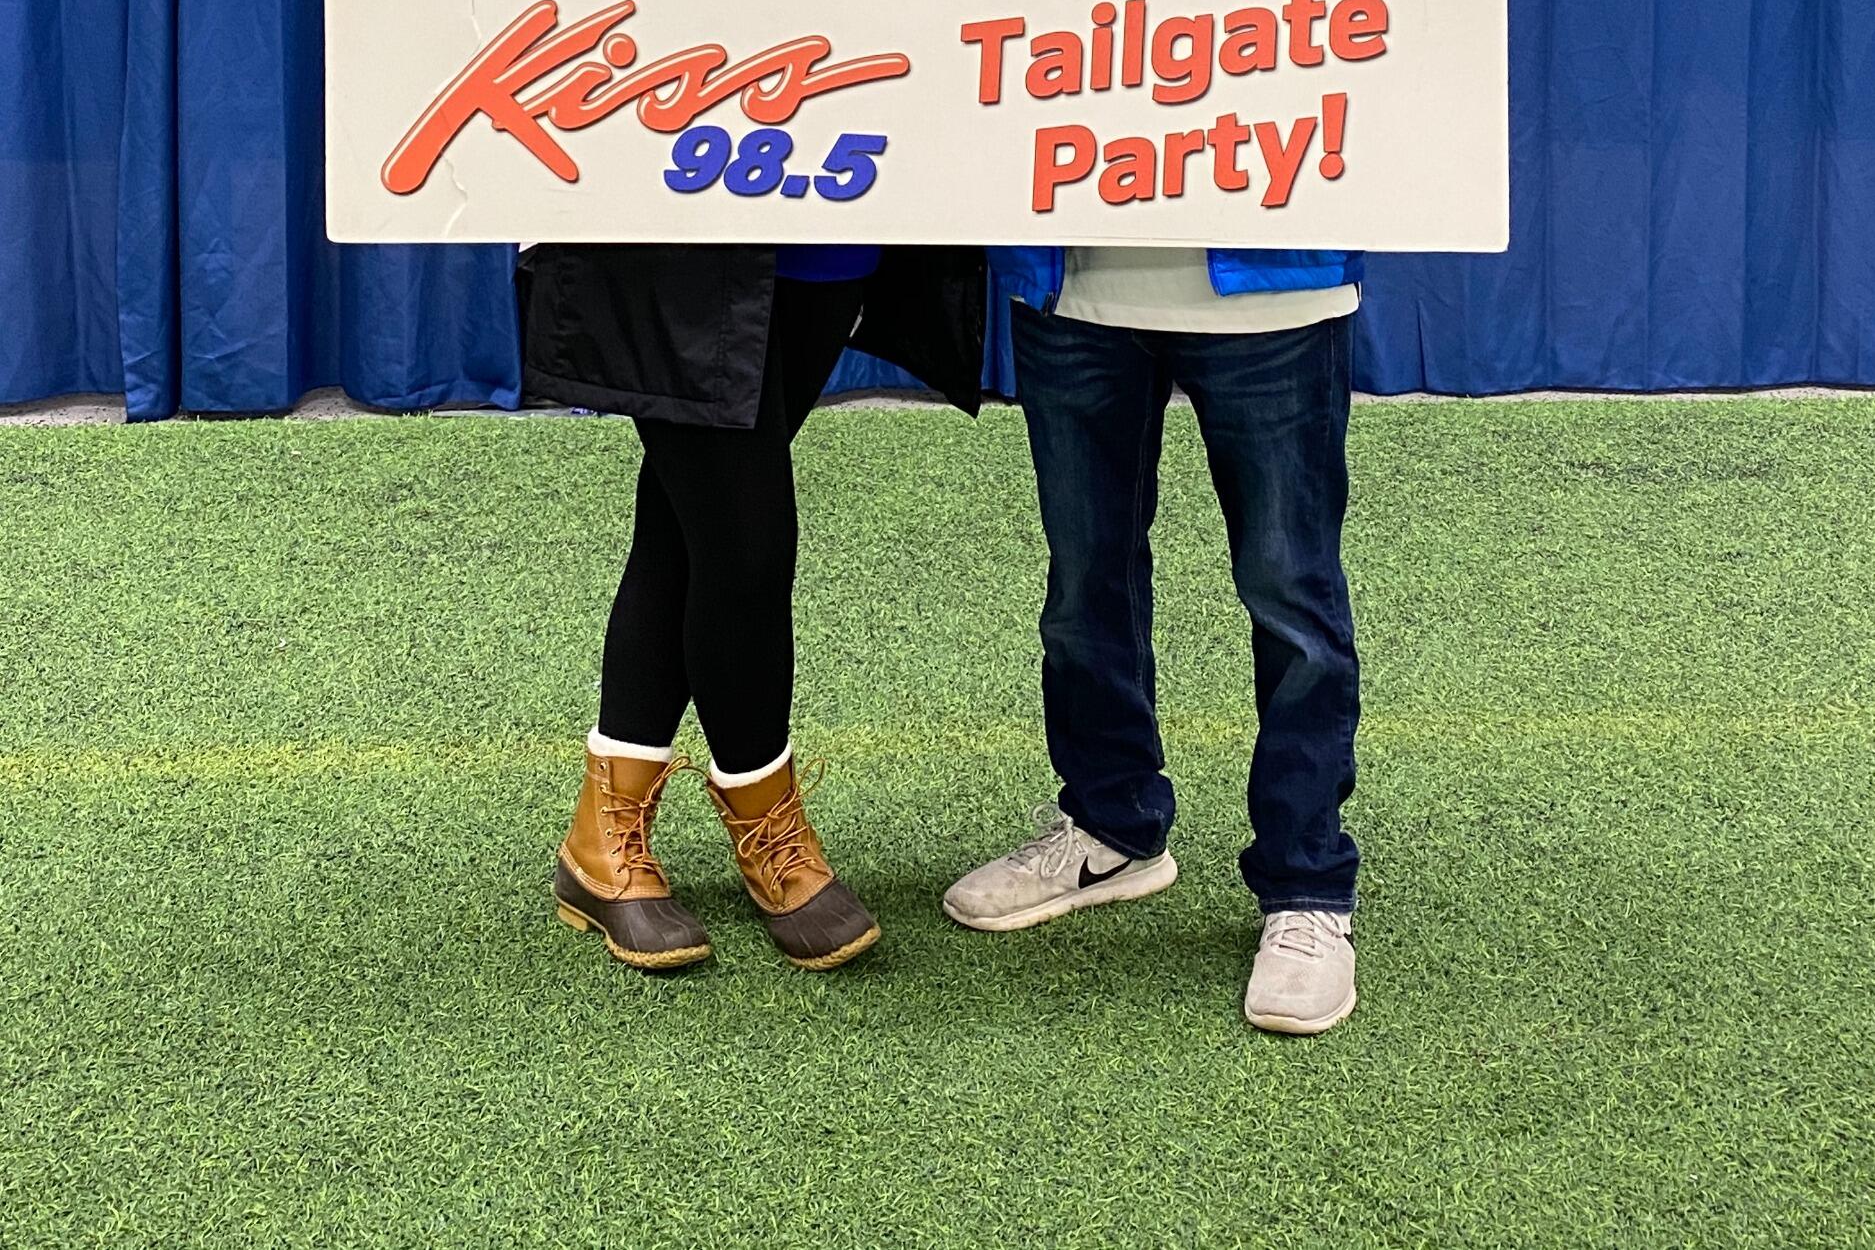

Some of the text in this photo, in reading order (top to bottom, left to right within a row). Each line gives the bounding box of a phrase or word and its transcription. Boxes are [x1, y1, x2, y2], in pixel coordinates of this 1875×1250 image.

[381, 0, 911, 196] Kiss
[1032, 92, 1348, 213] Party!
[663, 125, 889, 202] 98.5
